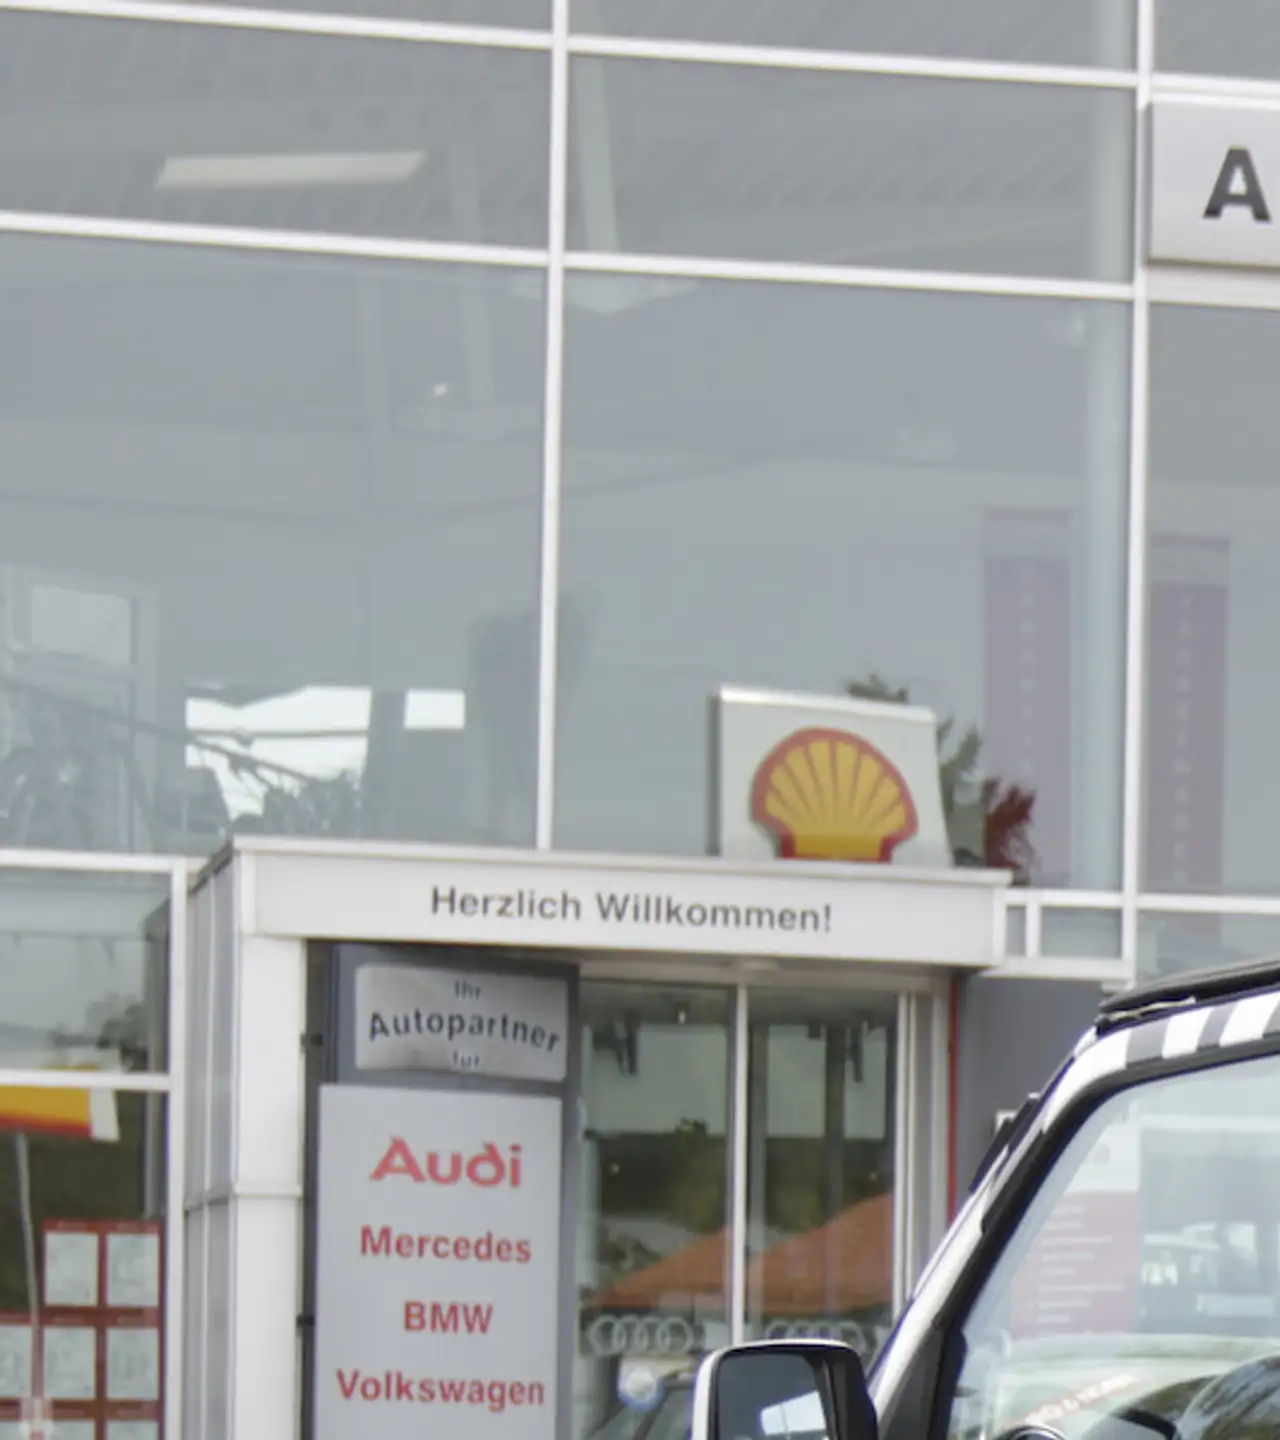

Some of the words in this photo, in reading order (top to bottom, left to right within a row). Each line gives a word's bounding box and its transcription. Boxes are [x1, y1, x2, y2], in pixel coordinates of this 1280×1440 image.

[431, 886, 582, 922] Herzlich
[595, 891, 832, 933] Willkommen!
[454, 979, 482, 1001] Ihr
[369, 1007, 561, 1053] Autopartner
[370, 1135, 523, 1189] Audi
[360, 1224, 533, 1265] Mercedes
[403, 1300, 494, 1335] BMW
[336, 1367, 546, 1414] Volkswagen
